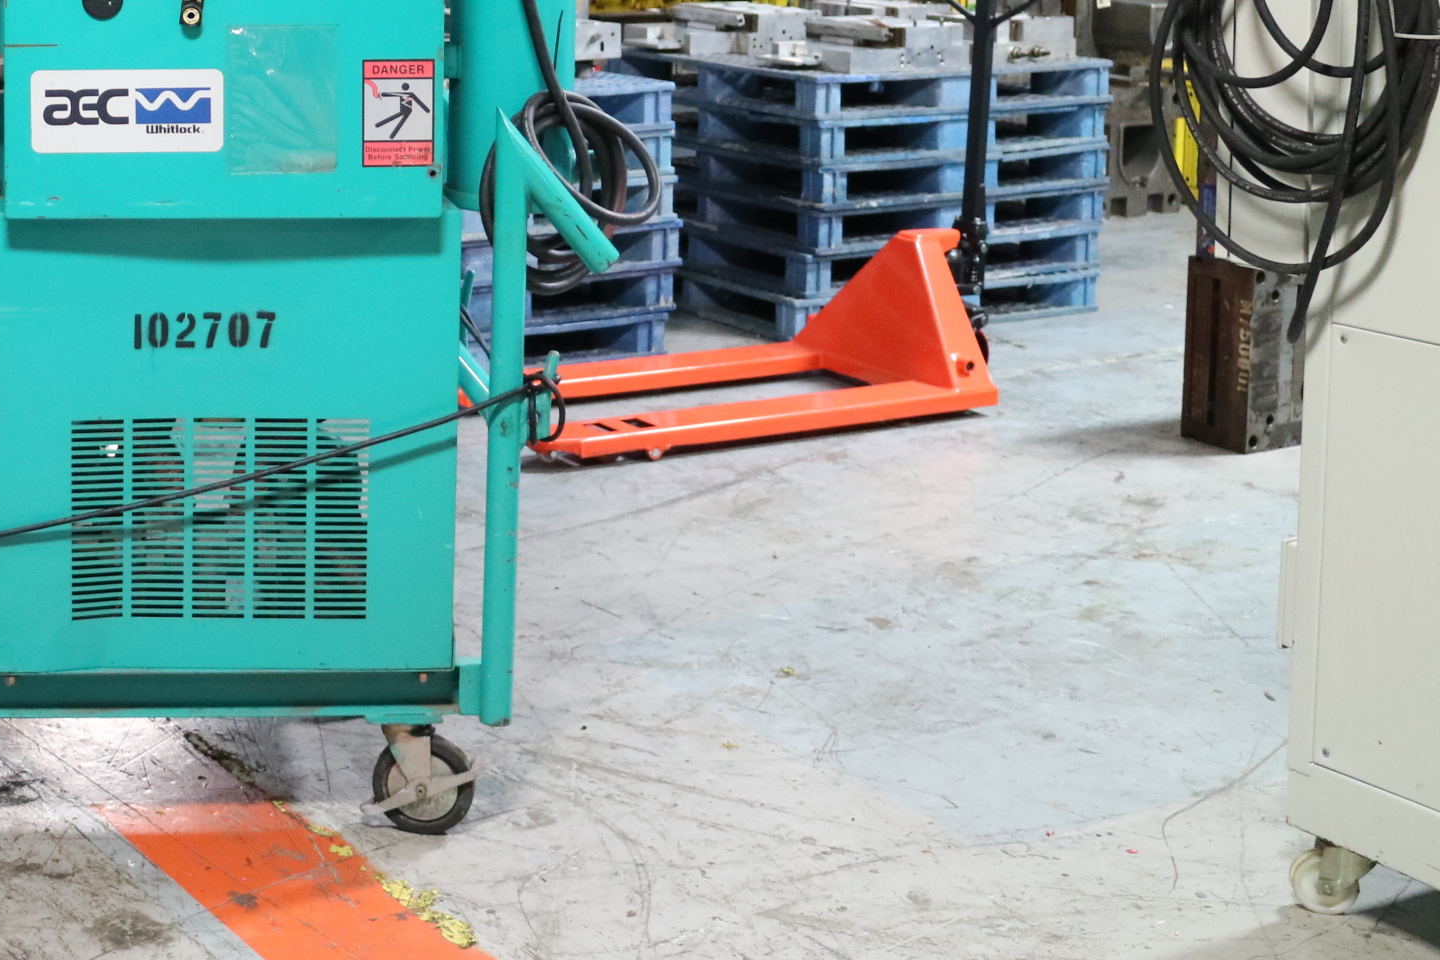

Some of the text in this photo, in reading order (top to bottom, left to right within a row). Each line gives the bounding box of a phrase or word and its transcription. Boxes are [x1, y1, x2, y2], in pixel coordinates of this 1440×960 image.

[372, 64, 424, 74] DANGER
[146, 125, 201, 134] Whitlock
[134, 311, 276, 349] 102707
